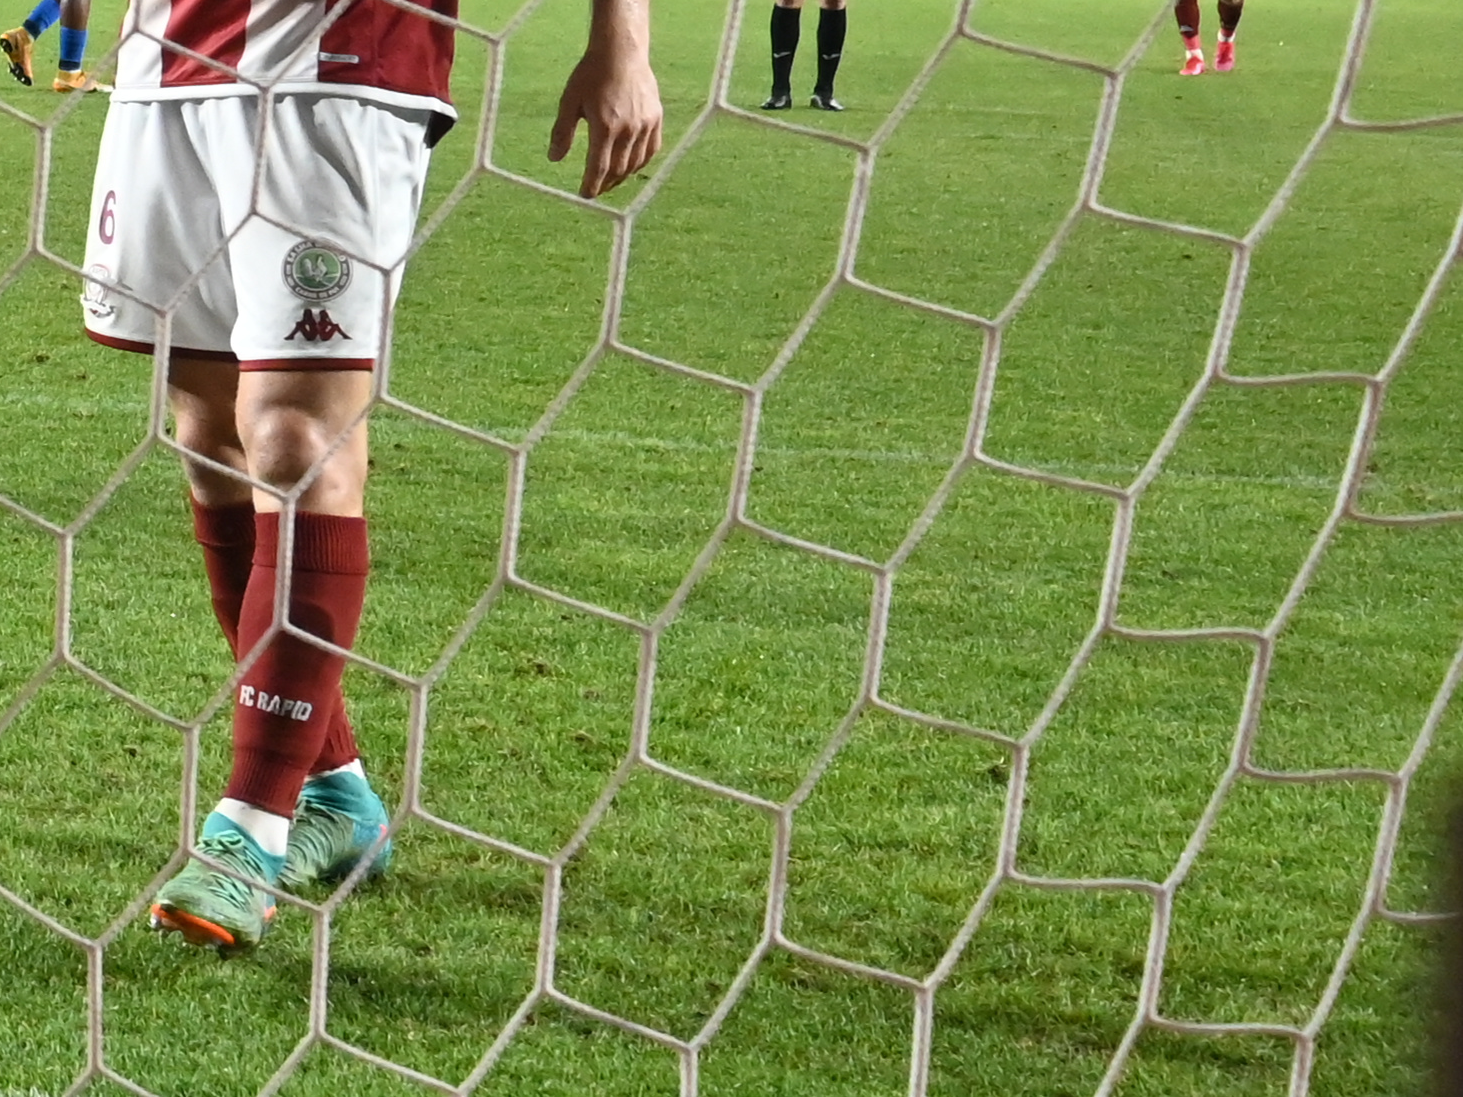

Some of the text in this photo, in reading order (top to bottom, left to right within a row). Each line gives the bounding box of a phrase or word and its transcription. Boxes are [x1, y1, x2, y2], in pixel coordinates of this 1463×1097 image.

[99, 190, 117, 245] 6
[239, 684, 313, 721] FC RAPID
